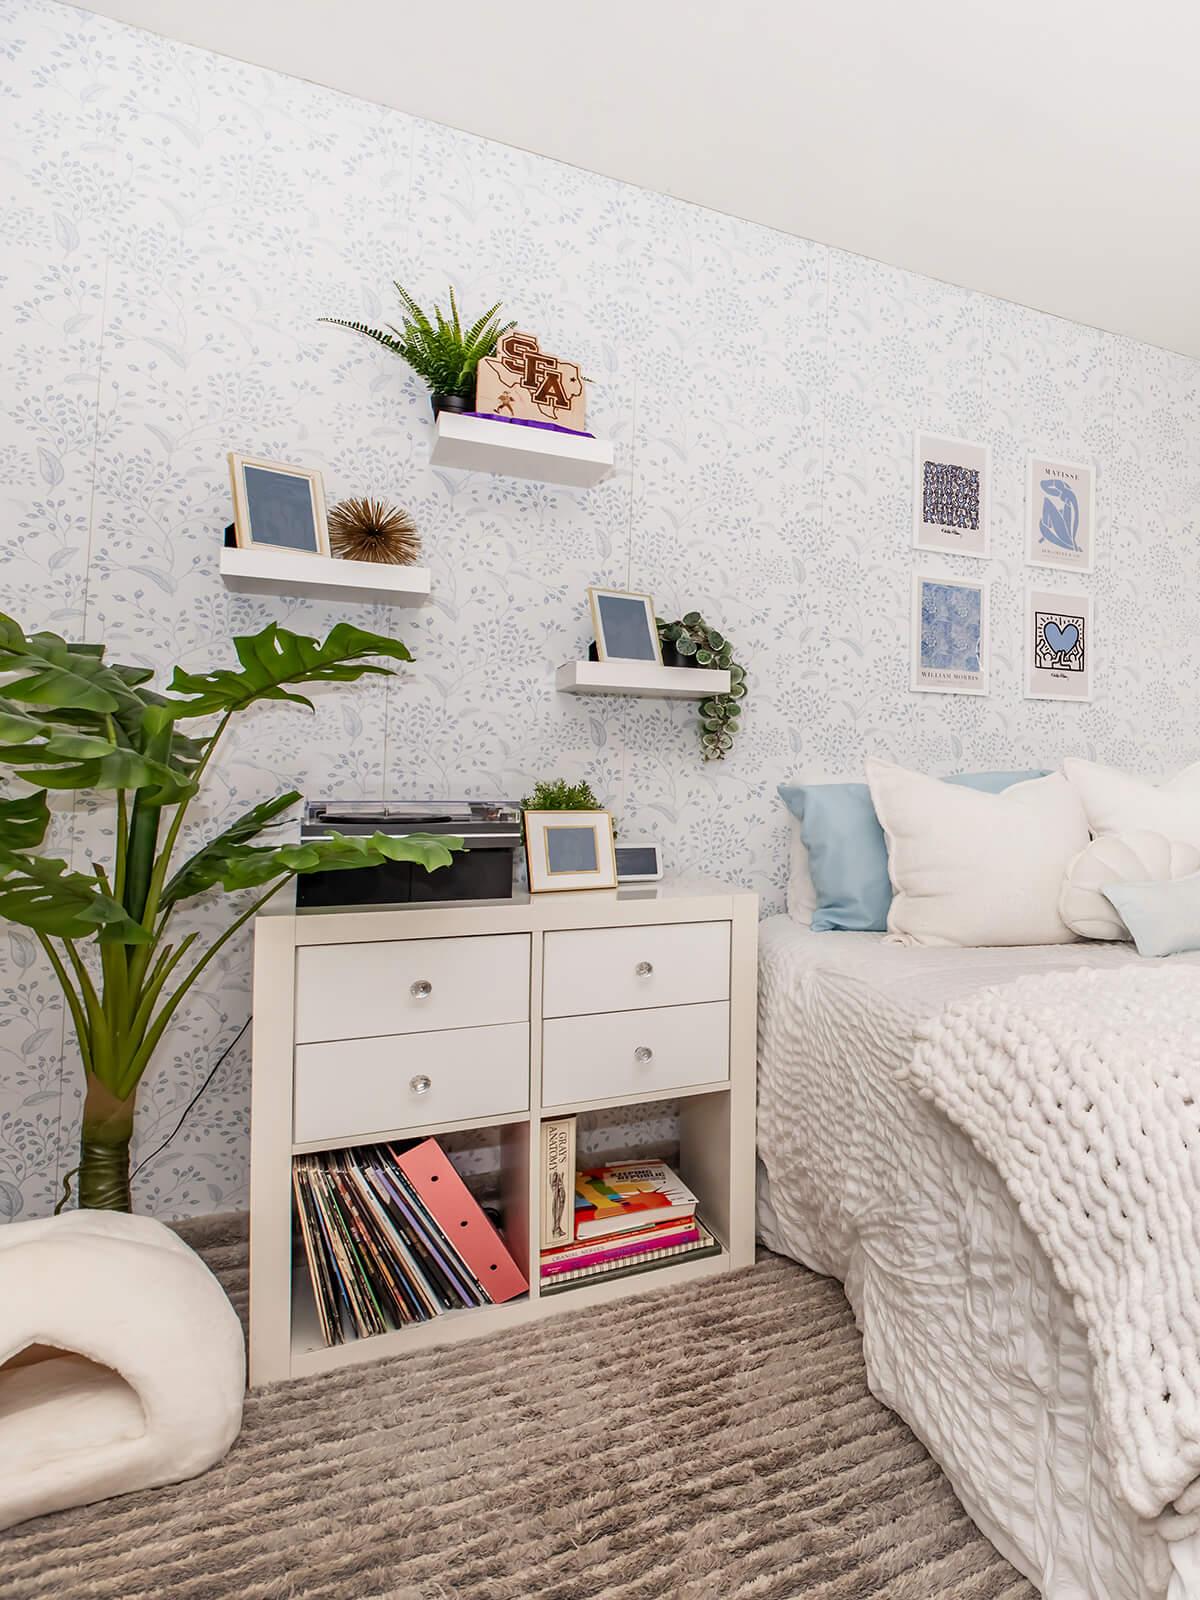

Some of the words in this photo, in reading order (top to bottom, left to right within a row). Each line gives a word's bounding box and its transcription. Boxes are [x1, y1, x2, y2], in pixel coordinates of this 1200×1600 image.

[501, 332, 572, 411] SFA
[921, 670, 952, 680] WILLIAM
[953, 673, 979, 681] MORRIS
[549, 1126, 558, 1171] ANATOMY
[617, 1171, 665, 1180] REPUBLIC
[580, 1245, 605, 1255] NERVES
